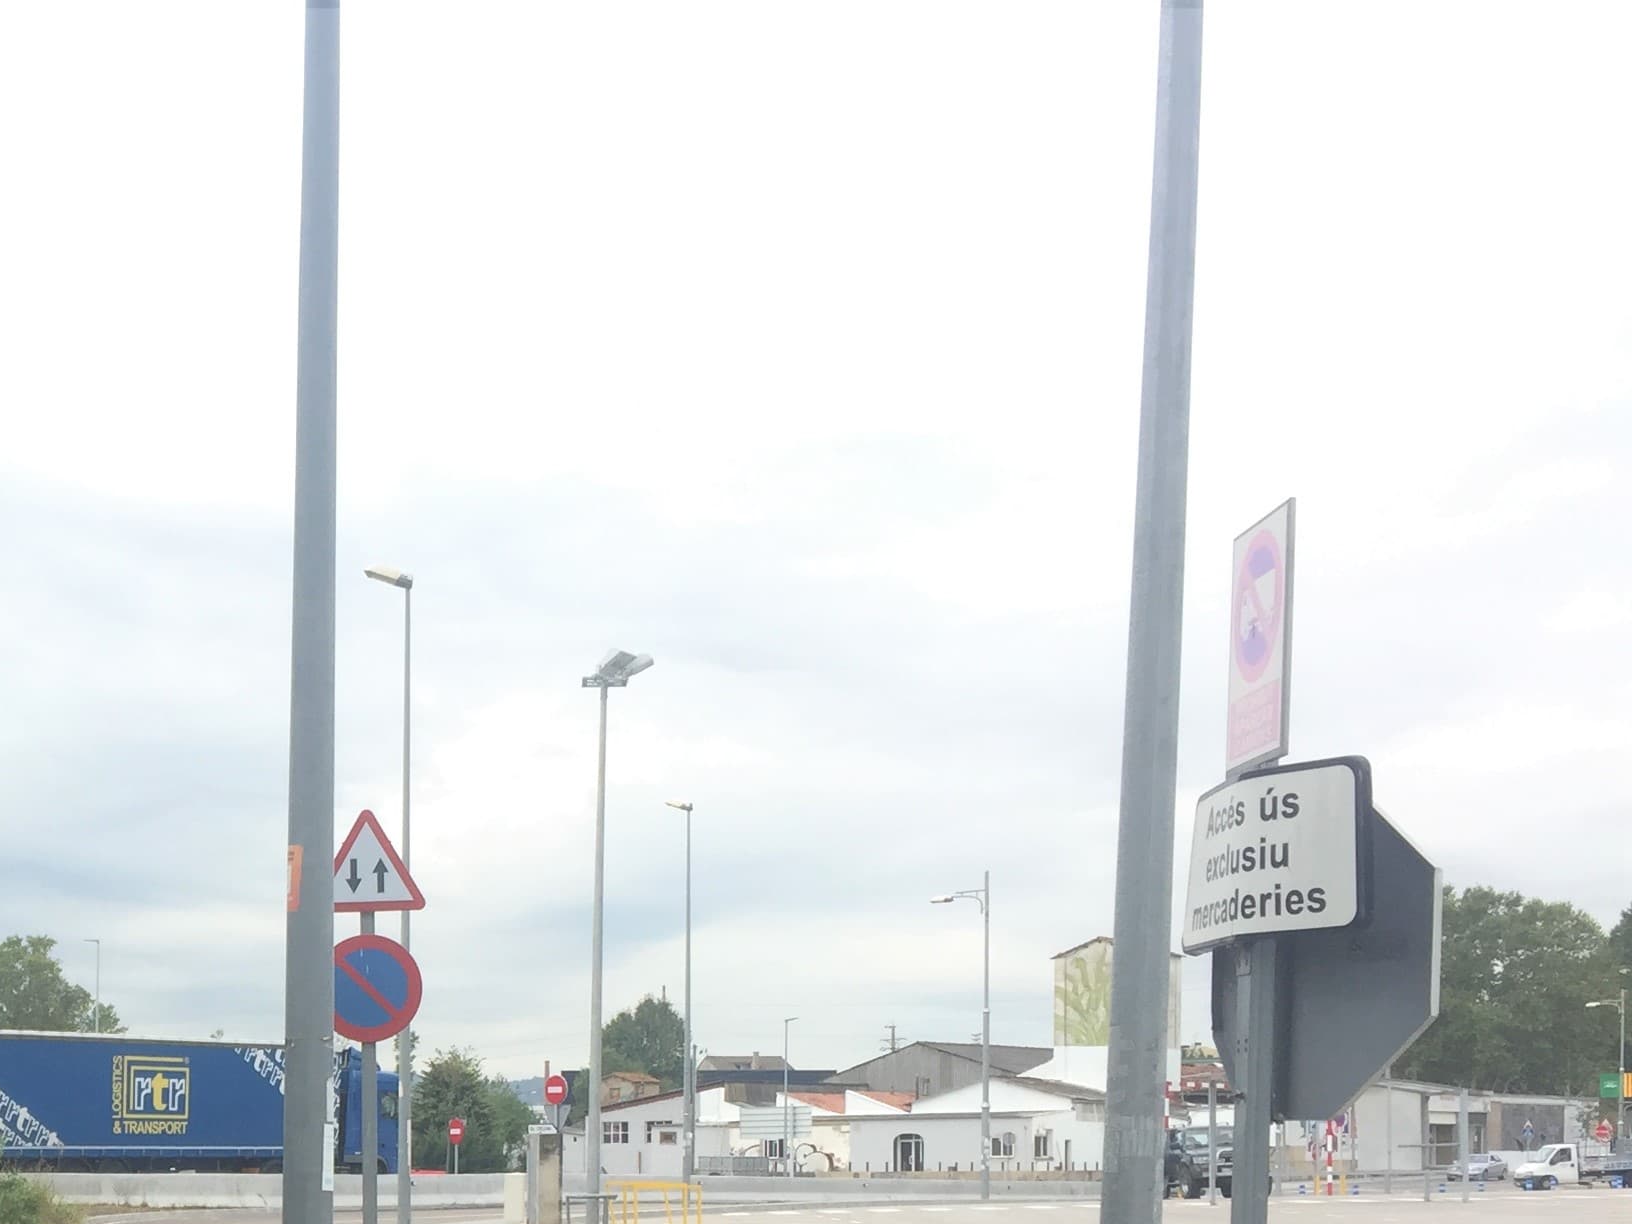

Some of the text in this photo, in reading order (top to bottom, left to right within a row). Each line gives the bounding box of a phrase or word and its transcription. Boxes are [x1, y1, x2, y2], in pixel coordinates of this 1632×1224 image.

[1206, 787, 1301, 840] Accés ús
[1206, 837, 1290, 883] exclusiu
[1191, 883, 1327, 932] mercaderies
[112, 1055, 123, 1118] LOGISTICS
[134, 1072, 186, 1111] rtr
[113, 1121, 188, 1135] & TRANSPORT
